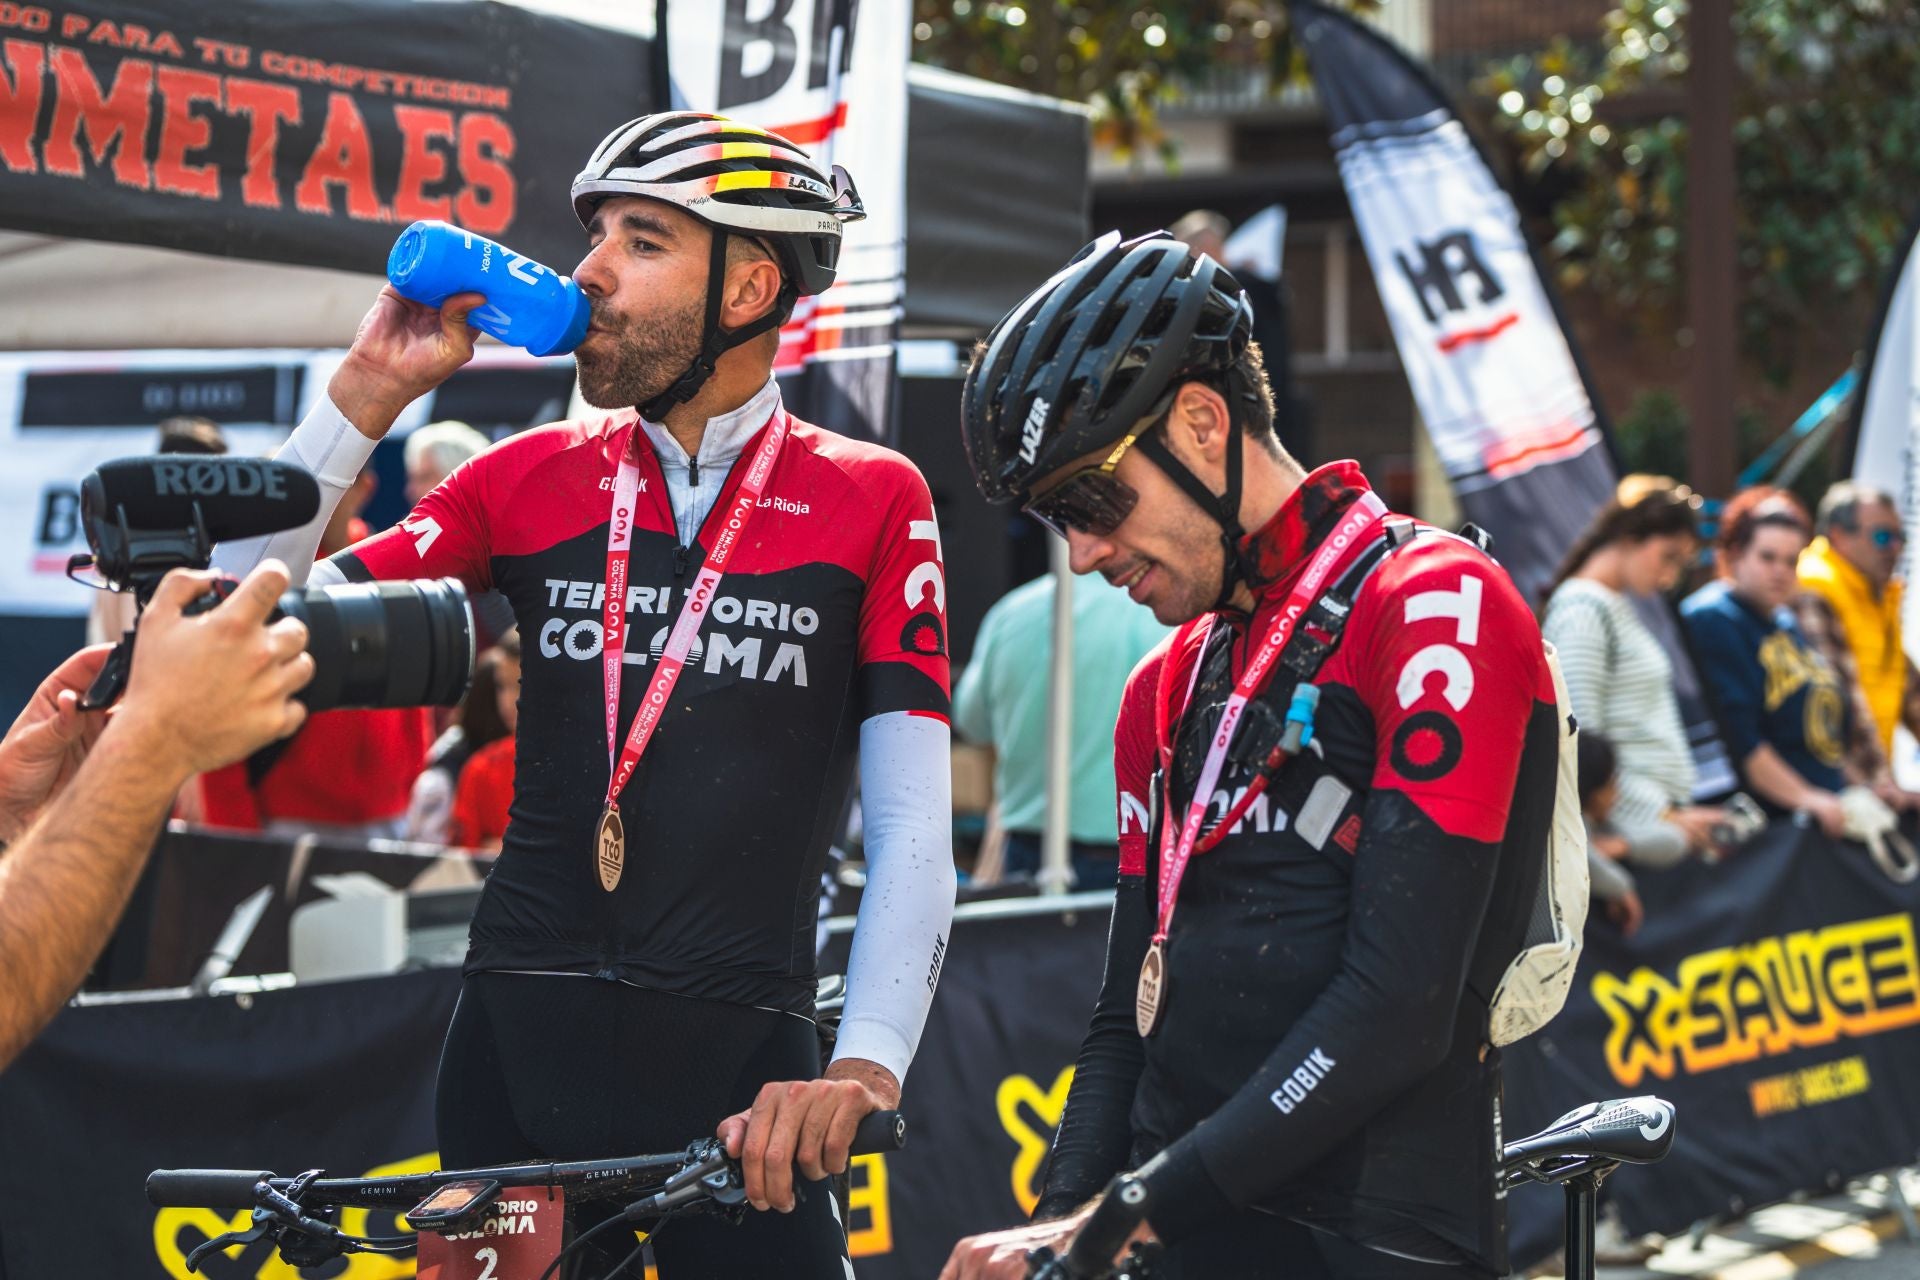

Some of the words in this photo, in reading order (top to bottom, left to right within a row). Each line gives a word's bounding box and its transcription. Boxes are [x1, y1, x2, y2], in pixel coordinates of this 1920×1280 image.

[62, 13, 184, 58] PARA
[194, 38, 250, 68] TU
[260, 51, 510, 108] COMPETICION
[1019, 396, 1050, 465] LAZER
[152, 463, 288, 500] RØDE
[755, 495, 772, 508] La
[773, 496, 810, 515] Rioja
[710, 528, 728, 561] TERRITORIO
[716, 531, 736, 564] COLOMA
[610, 560, 619, 599] COLOMA
[1390, 574, 1483, 782] TCO
[631, 703, 651, 741] TERRITORIO
[635, 706, 658, 745] COLOMA
[603, 838, 621, 862] TCO
[926, 933, 946, 995] GOBIK
[1270, 1046, 1337, 1115] GOBIK
[360, 1187, 397, 1195] GEMINI
[586, 1168, 629, 1179] GEMINI
[416, 1220, 446, 1228] GARMIN
[474, 1247, 498, 1280] 2
